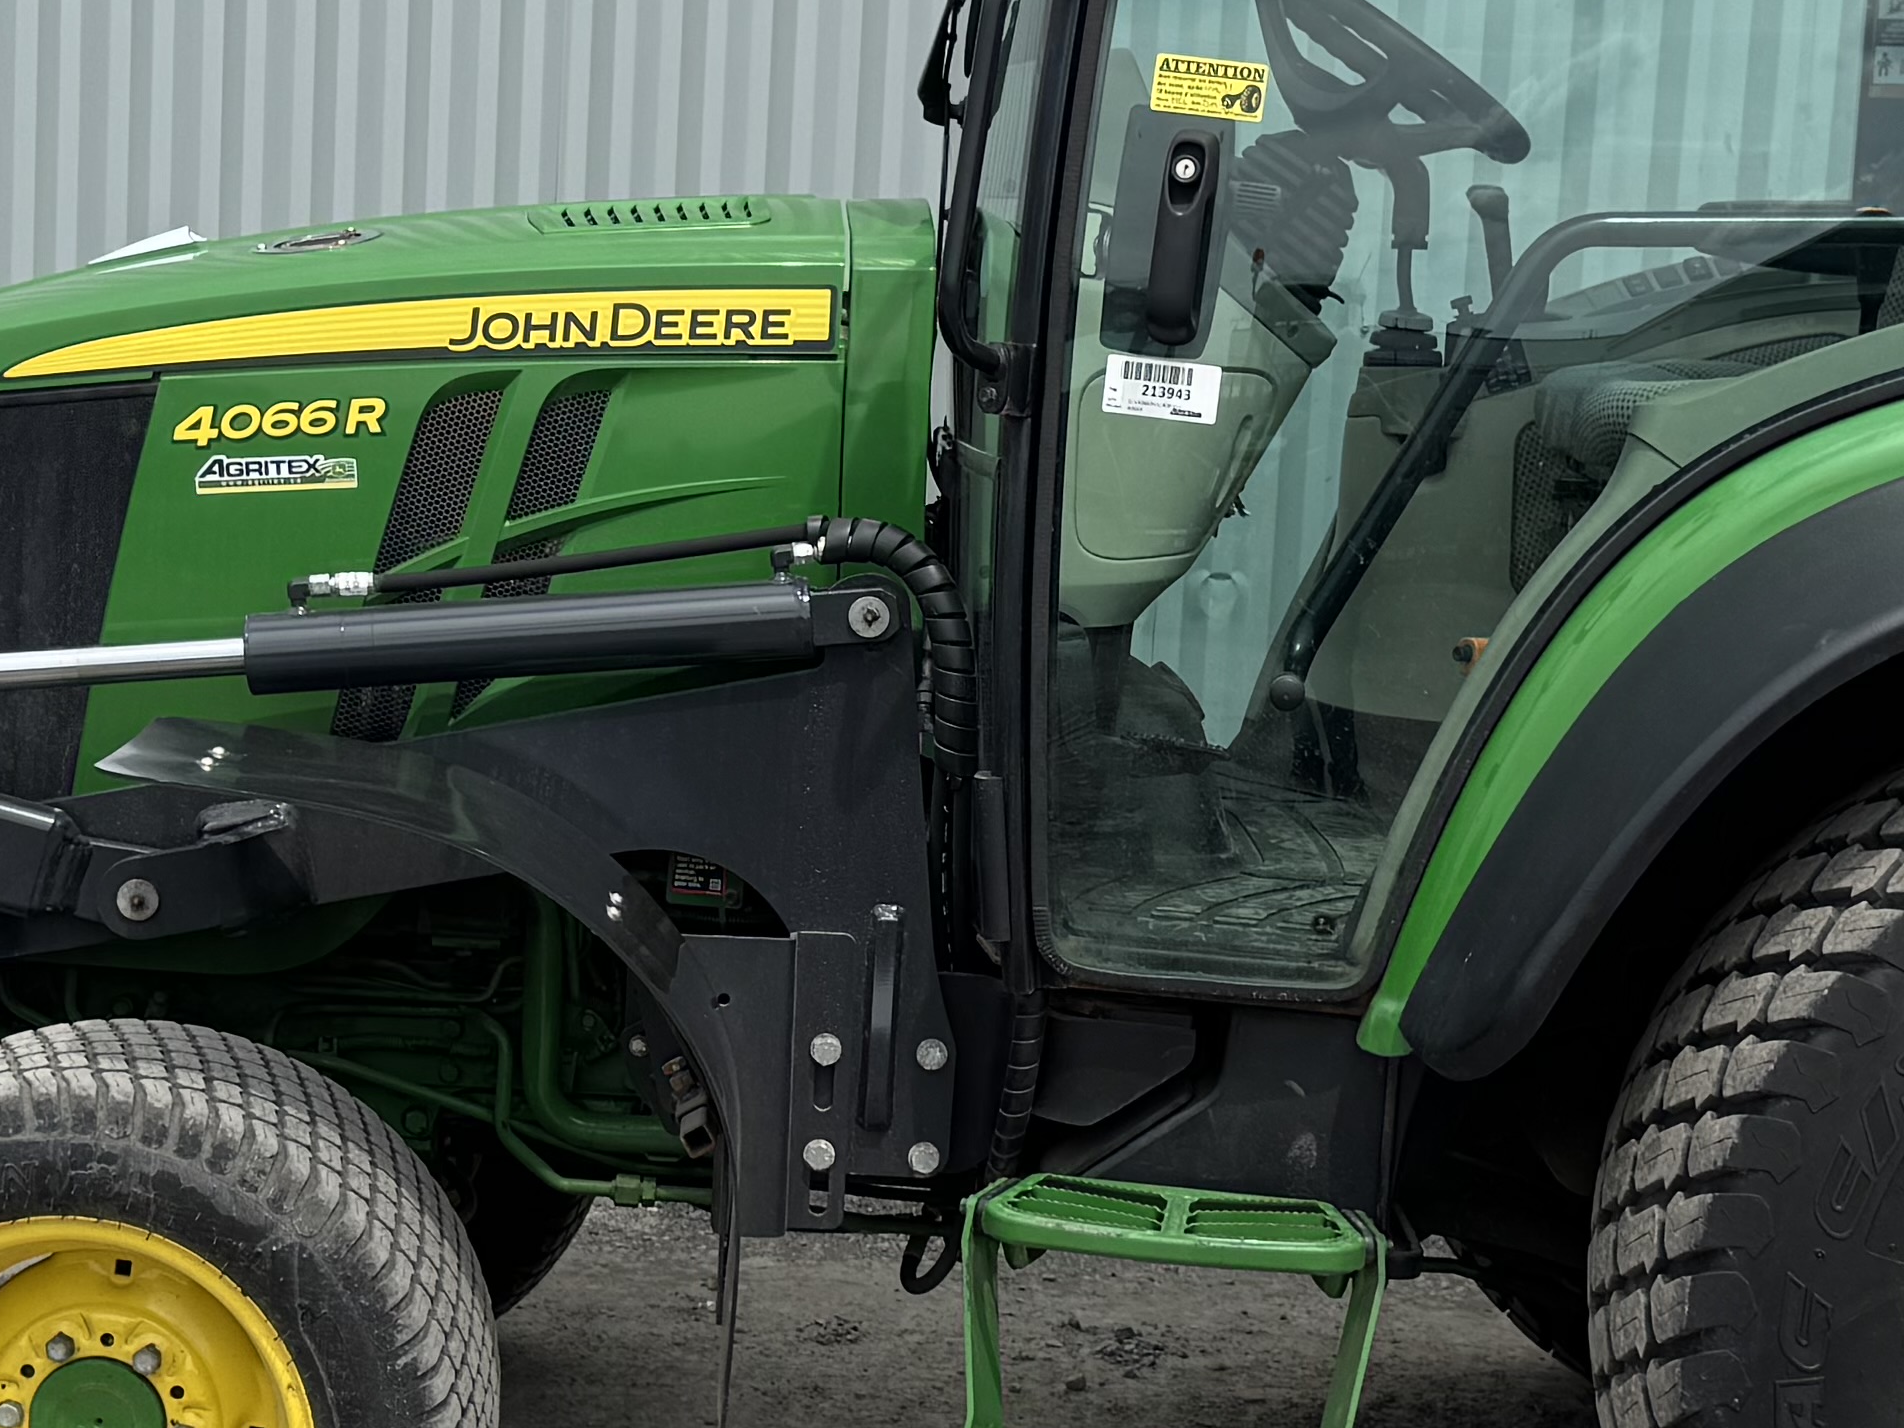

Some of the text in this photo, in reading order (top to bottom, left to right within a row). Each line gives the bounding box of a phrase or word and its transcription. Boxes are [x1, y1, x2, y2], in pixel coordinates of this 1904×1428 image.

[1159, 58, 1265, 80] ATTENTION
[449, 303, 792, 348] JOHN DEERE
[1142, 385, 1191, 400] 213943
[173, 397, 386, 447] 4066 R
[199, 458, 322, 478] AGRITEX
